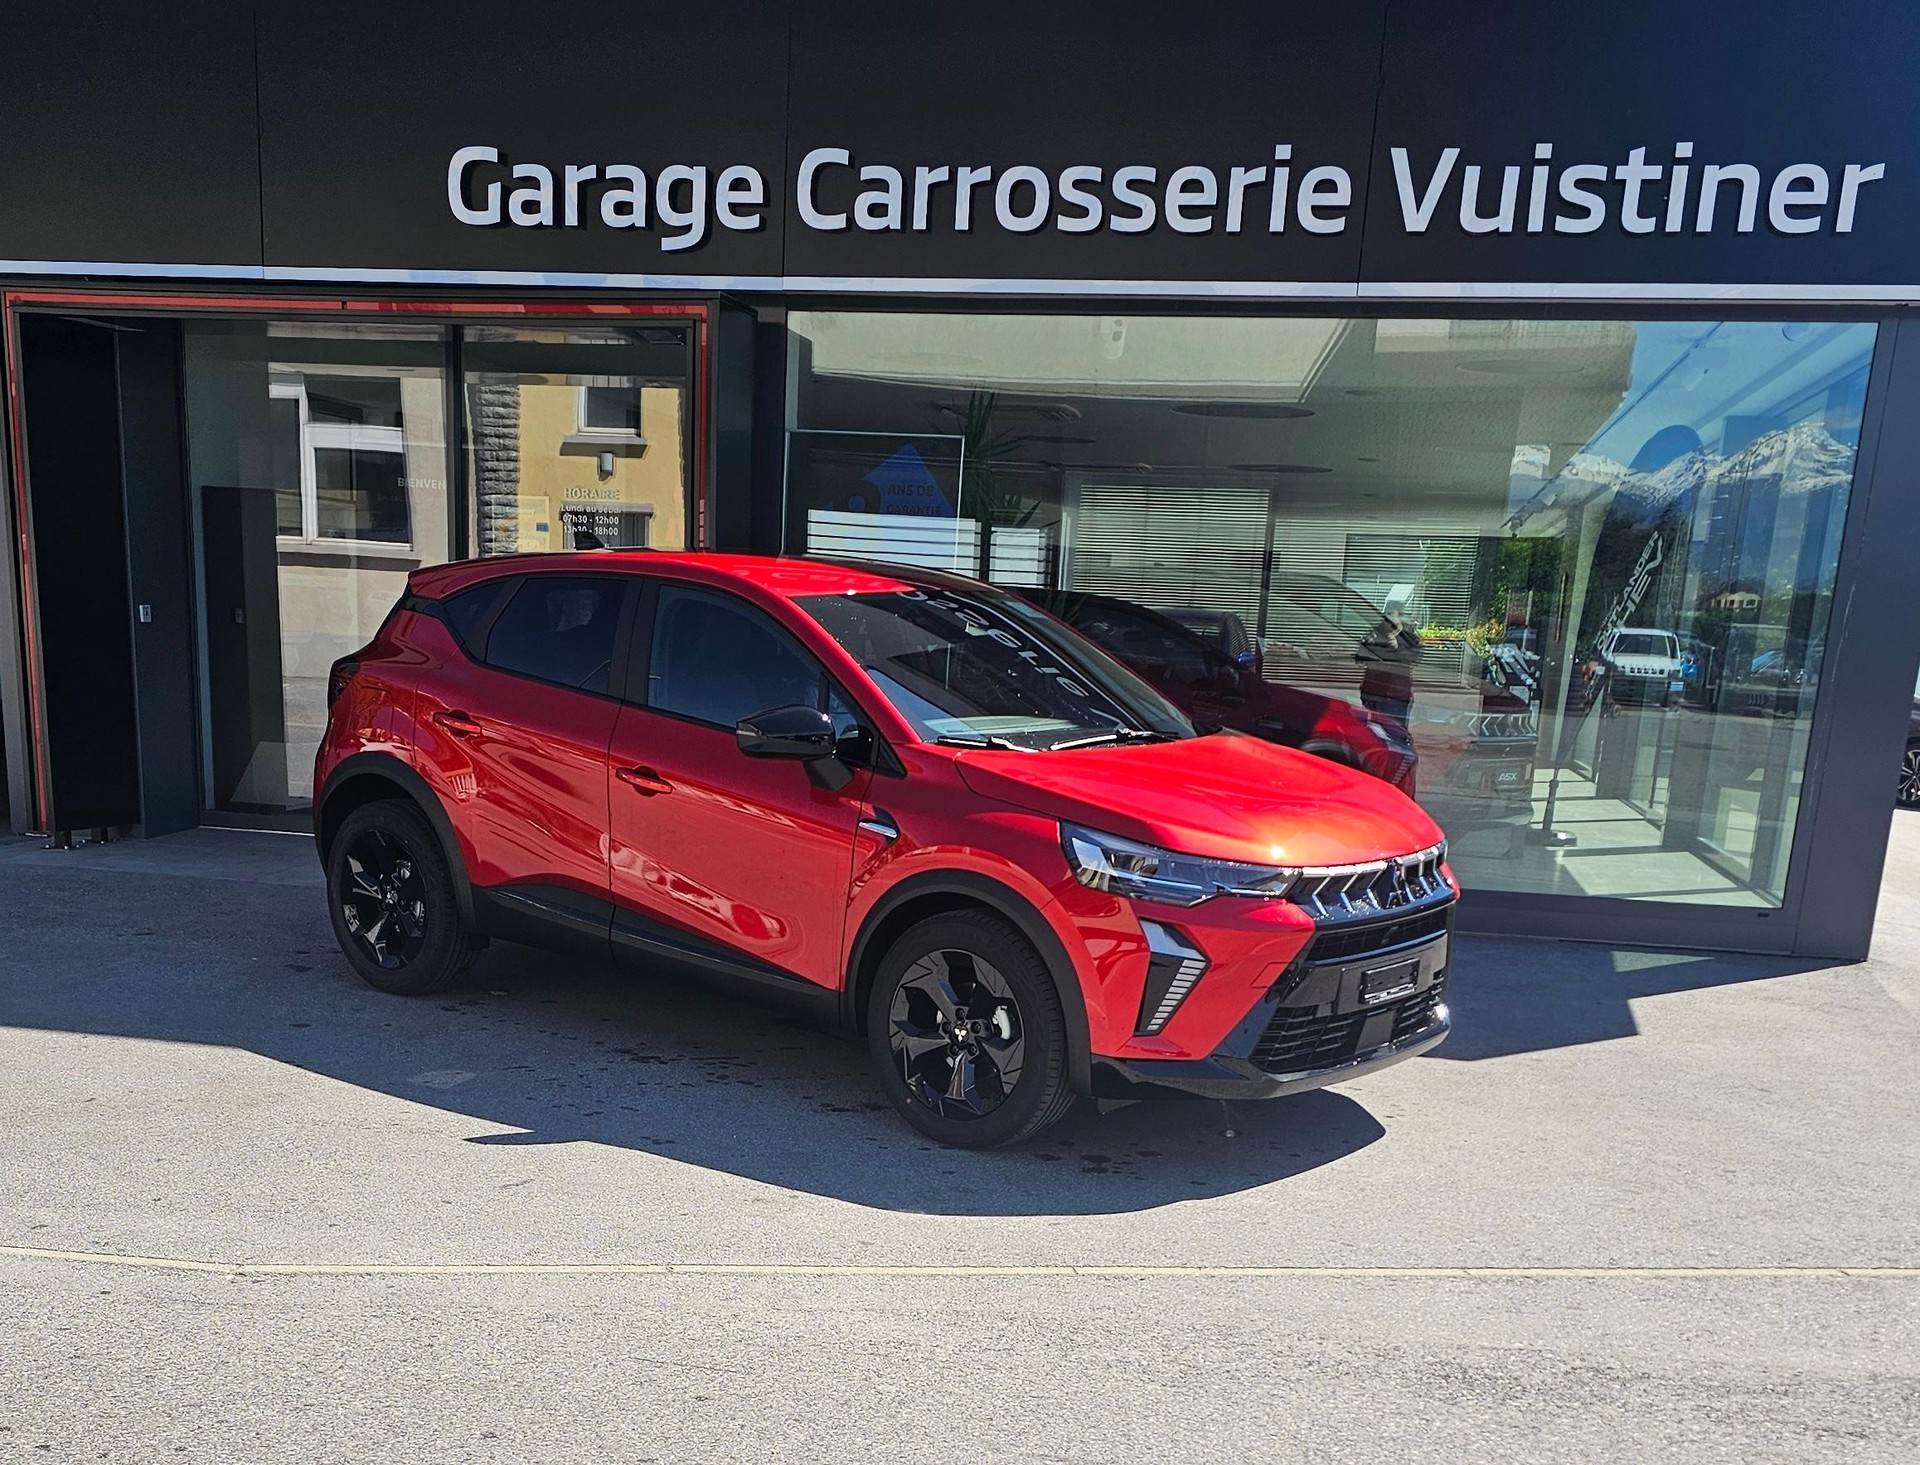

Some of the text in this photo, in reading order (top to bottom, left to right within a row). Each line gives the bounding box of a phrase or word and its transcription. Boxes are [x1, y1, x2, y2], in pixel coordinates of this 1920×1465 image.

[447, 142, 1885, 252] Garage Carrosserie Vuistiner
[564, 487, 620, 501] HORAIRE
[887, 484, 934, 497] ANS DE
[562, 514, 588, 524] 07h30
[595, 515, 619, 525] 12h00
[594, 526, 619, 536] 18h00
[1597, 531, 1659, 651] OUTLANDER
